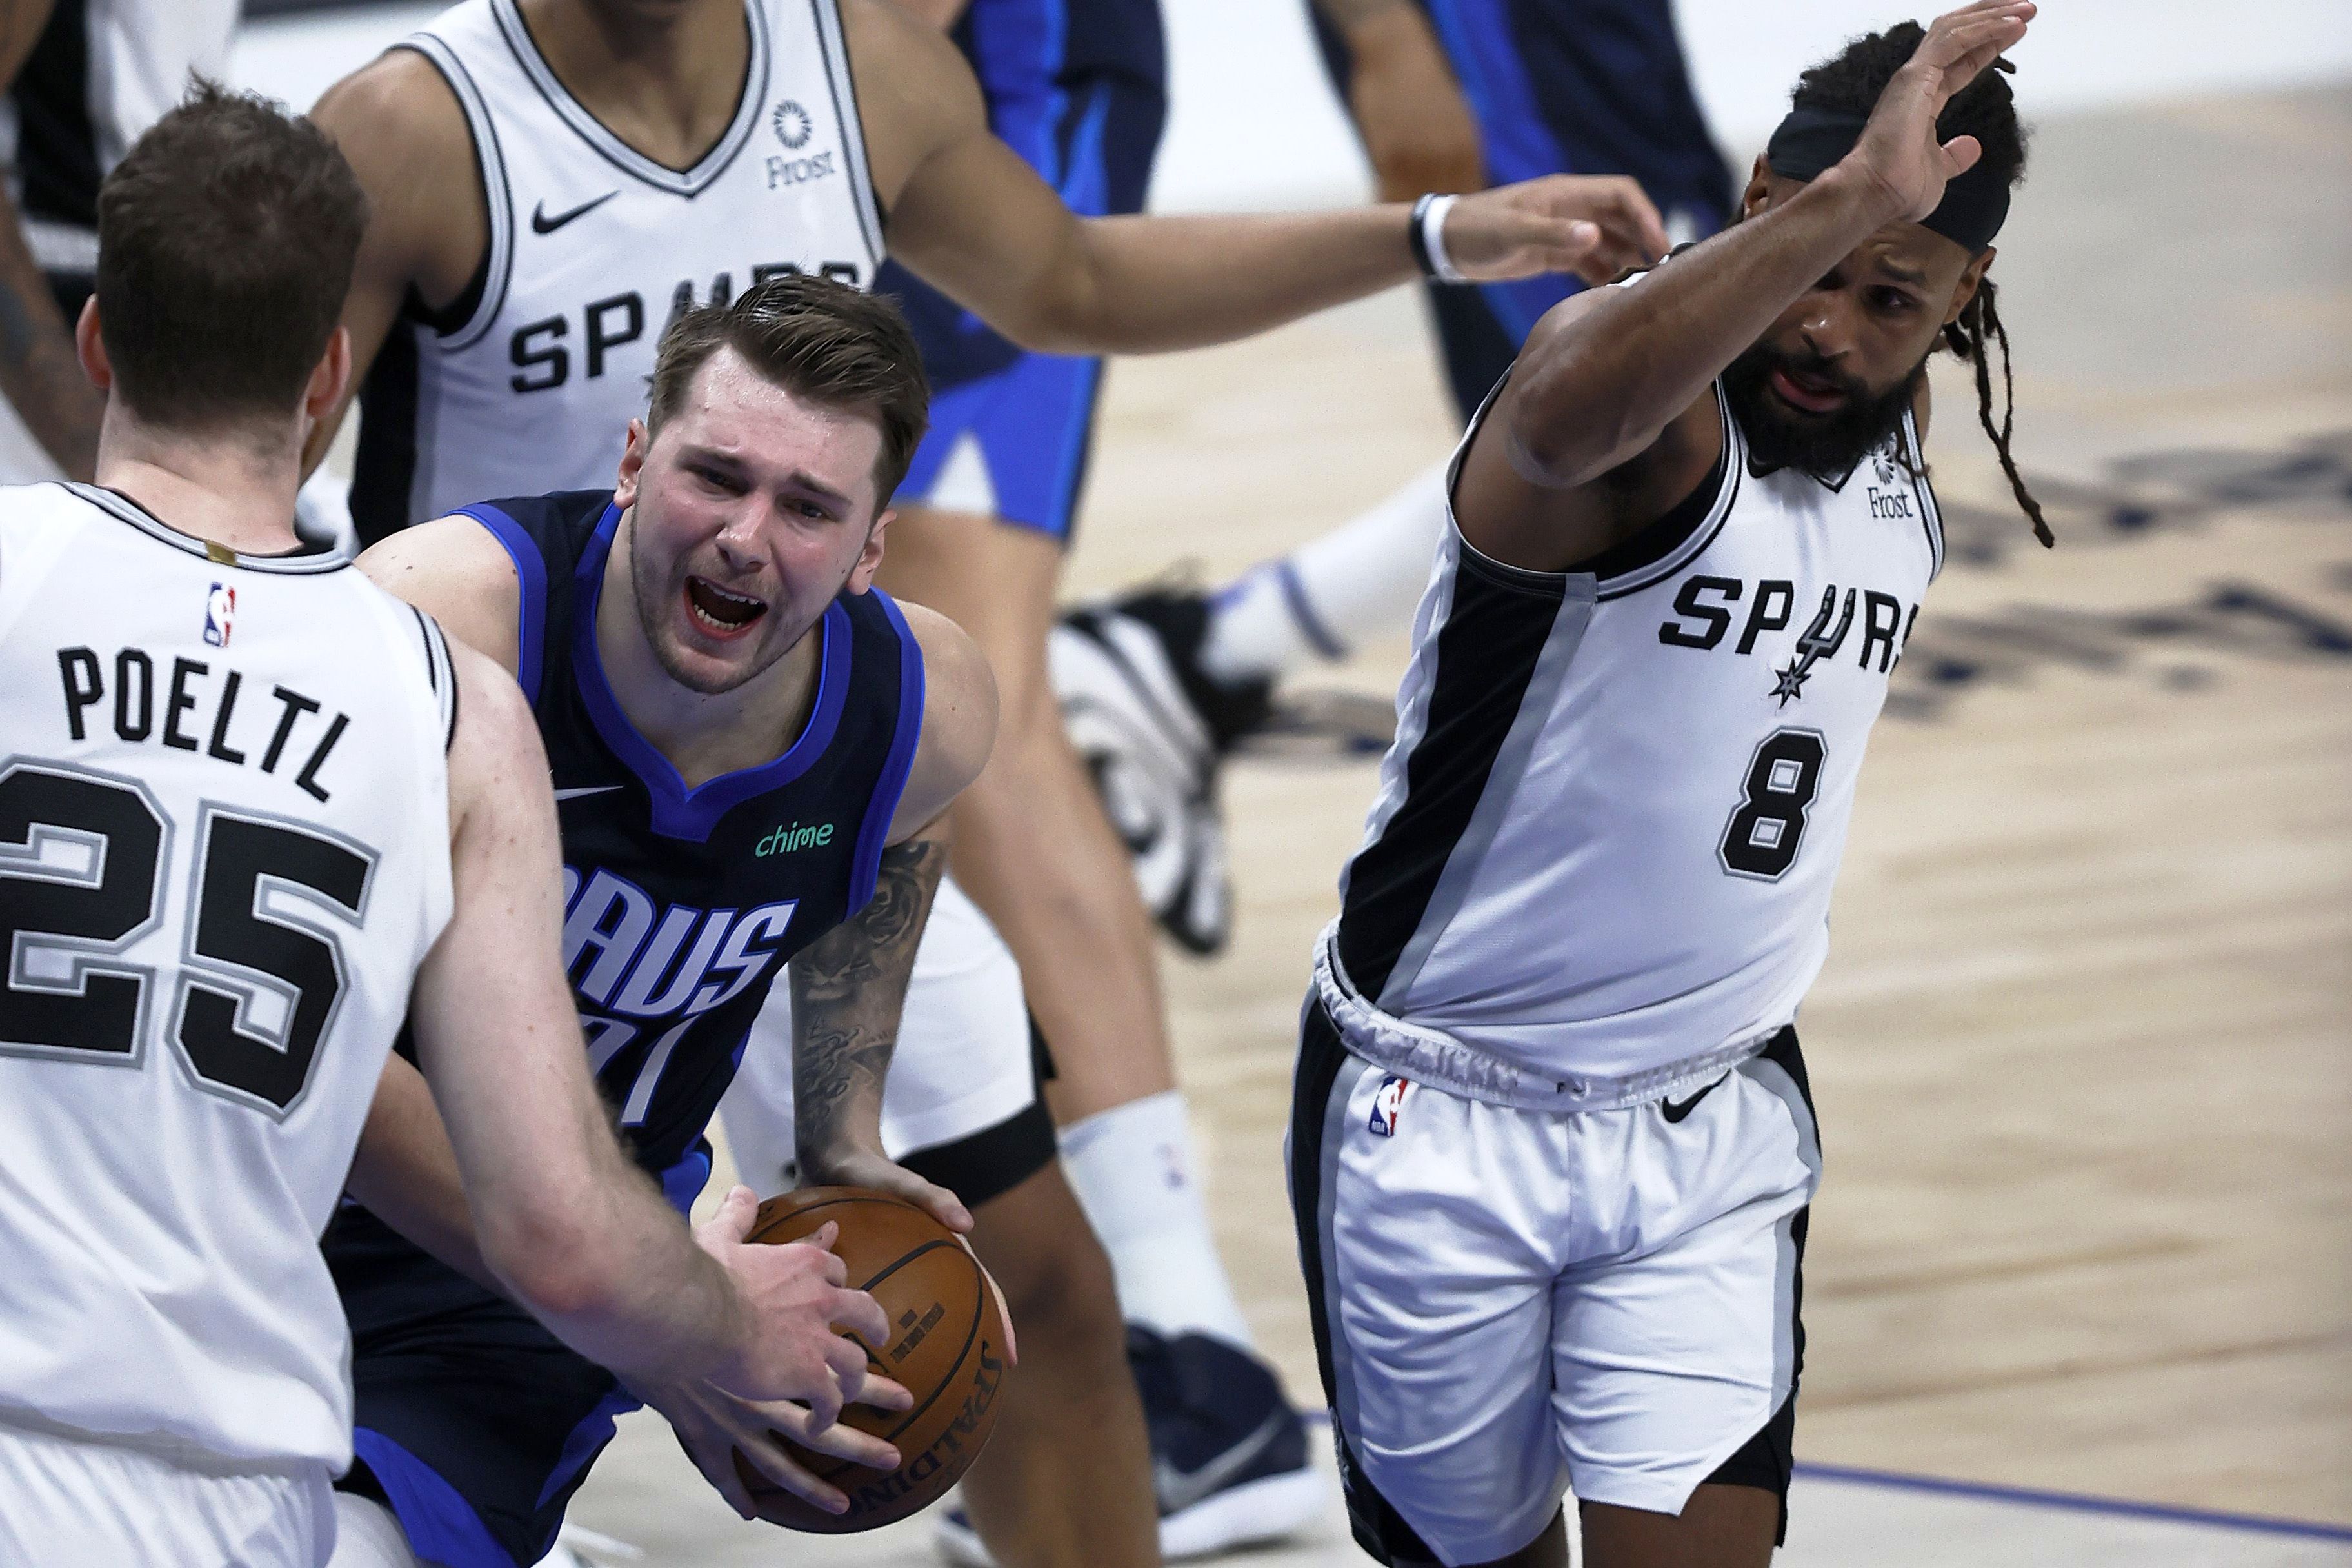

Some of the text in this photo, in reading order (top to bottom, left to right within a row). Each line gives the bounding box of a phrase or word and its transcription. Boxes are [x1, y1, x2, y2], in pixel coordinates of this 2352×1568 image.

[766, 150, 835, 190] Frost
[1867, 486, 1913, 518] Frost
[1659, 574, 1920, 686] SPUR
[58, 646, 351, 804] POELTL
[755, 820, 834, 857] chime
[1715, 724, 1829, 883] 8
[0, 752, 381, 1124] 25
[563, 863, 800, 1017] AVS
